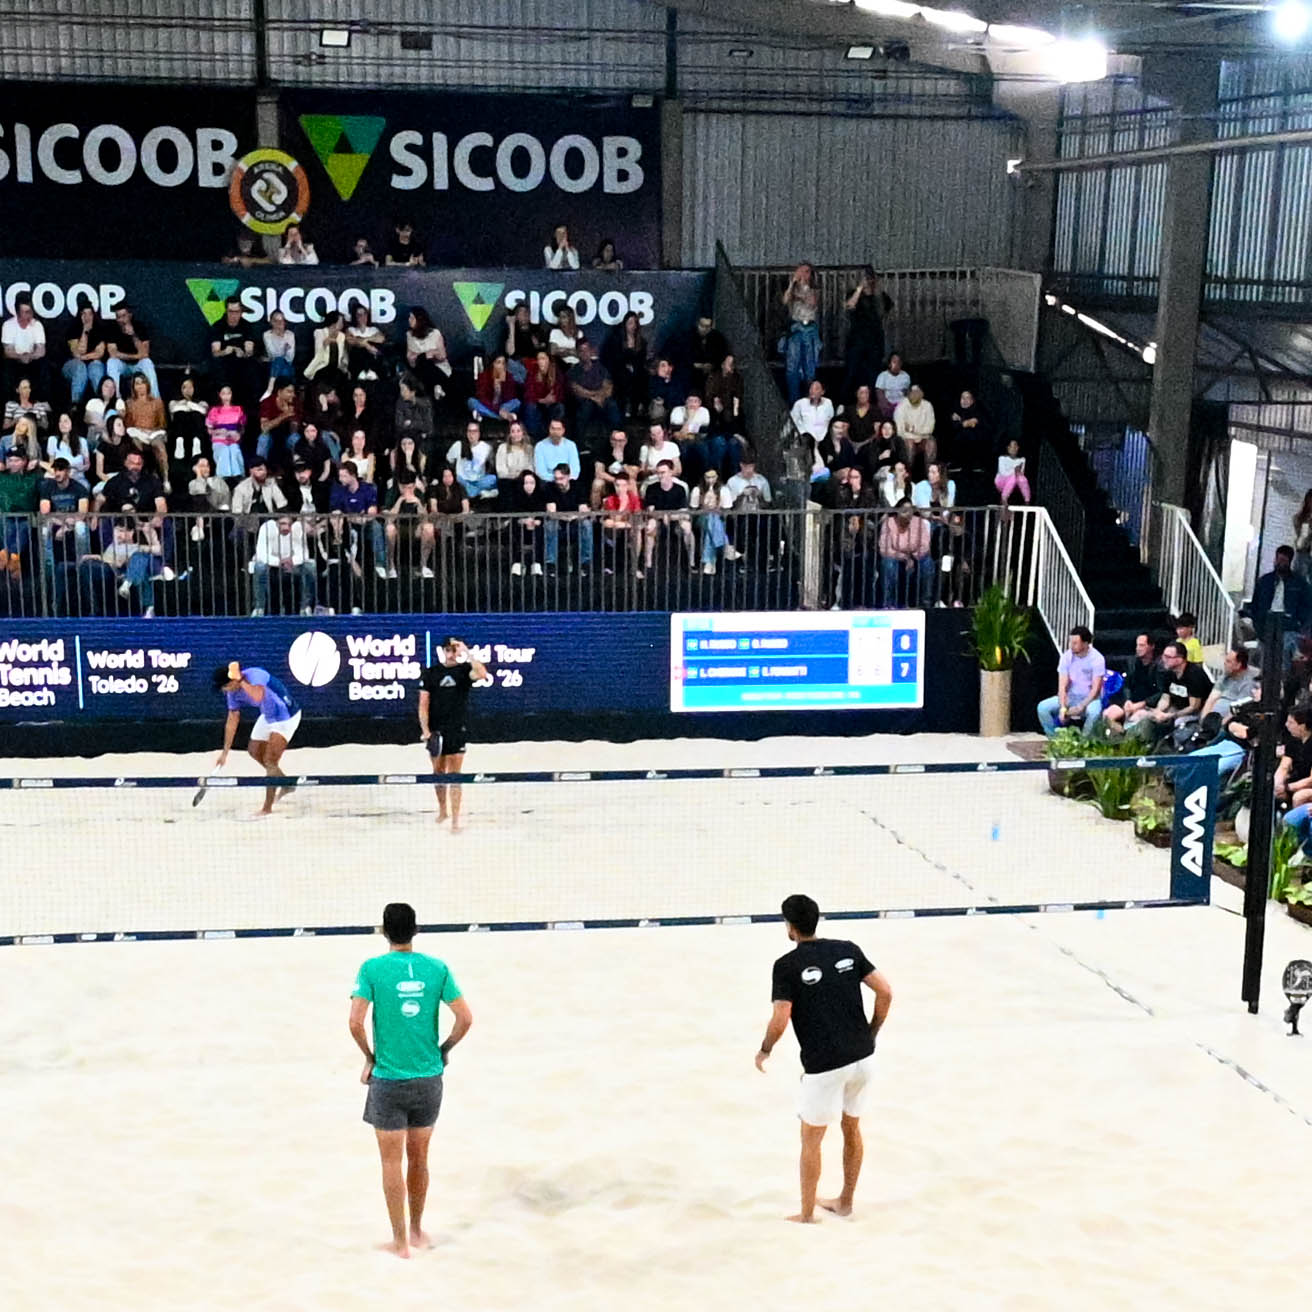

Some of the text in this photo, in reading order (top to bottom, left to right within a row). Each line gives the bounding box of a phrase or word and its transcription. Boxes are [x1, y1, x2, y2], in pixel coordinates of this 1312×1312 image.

[390, 130, 645, 194] SICOOB
[240, 286, 397, 324] SICOOB
[346, 633, 416, 658] World
[494, 644, 536, 663] Tour
[87, 649, 192, 669] World Tour
[348, 657, 422, 681] Tennis
[88, 675, 148, 695] Toledo
[349, 681, 406, 701] Beach
